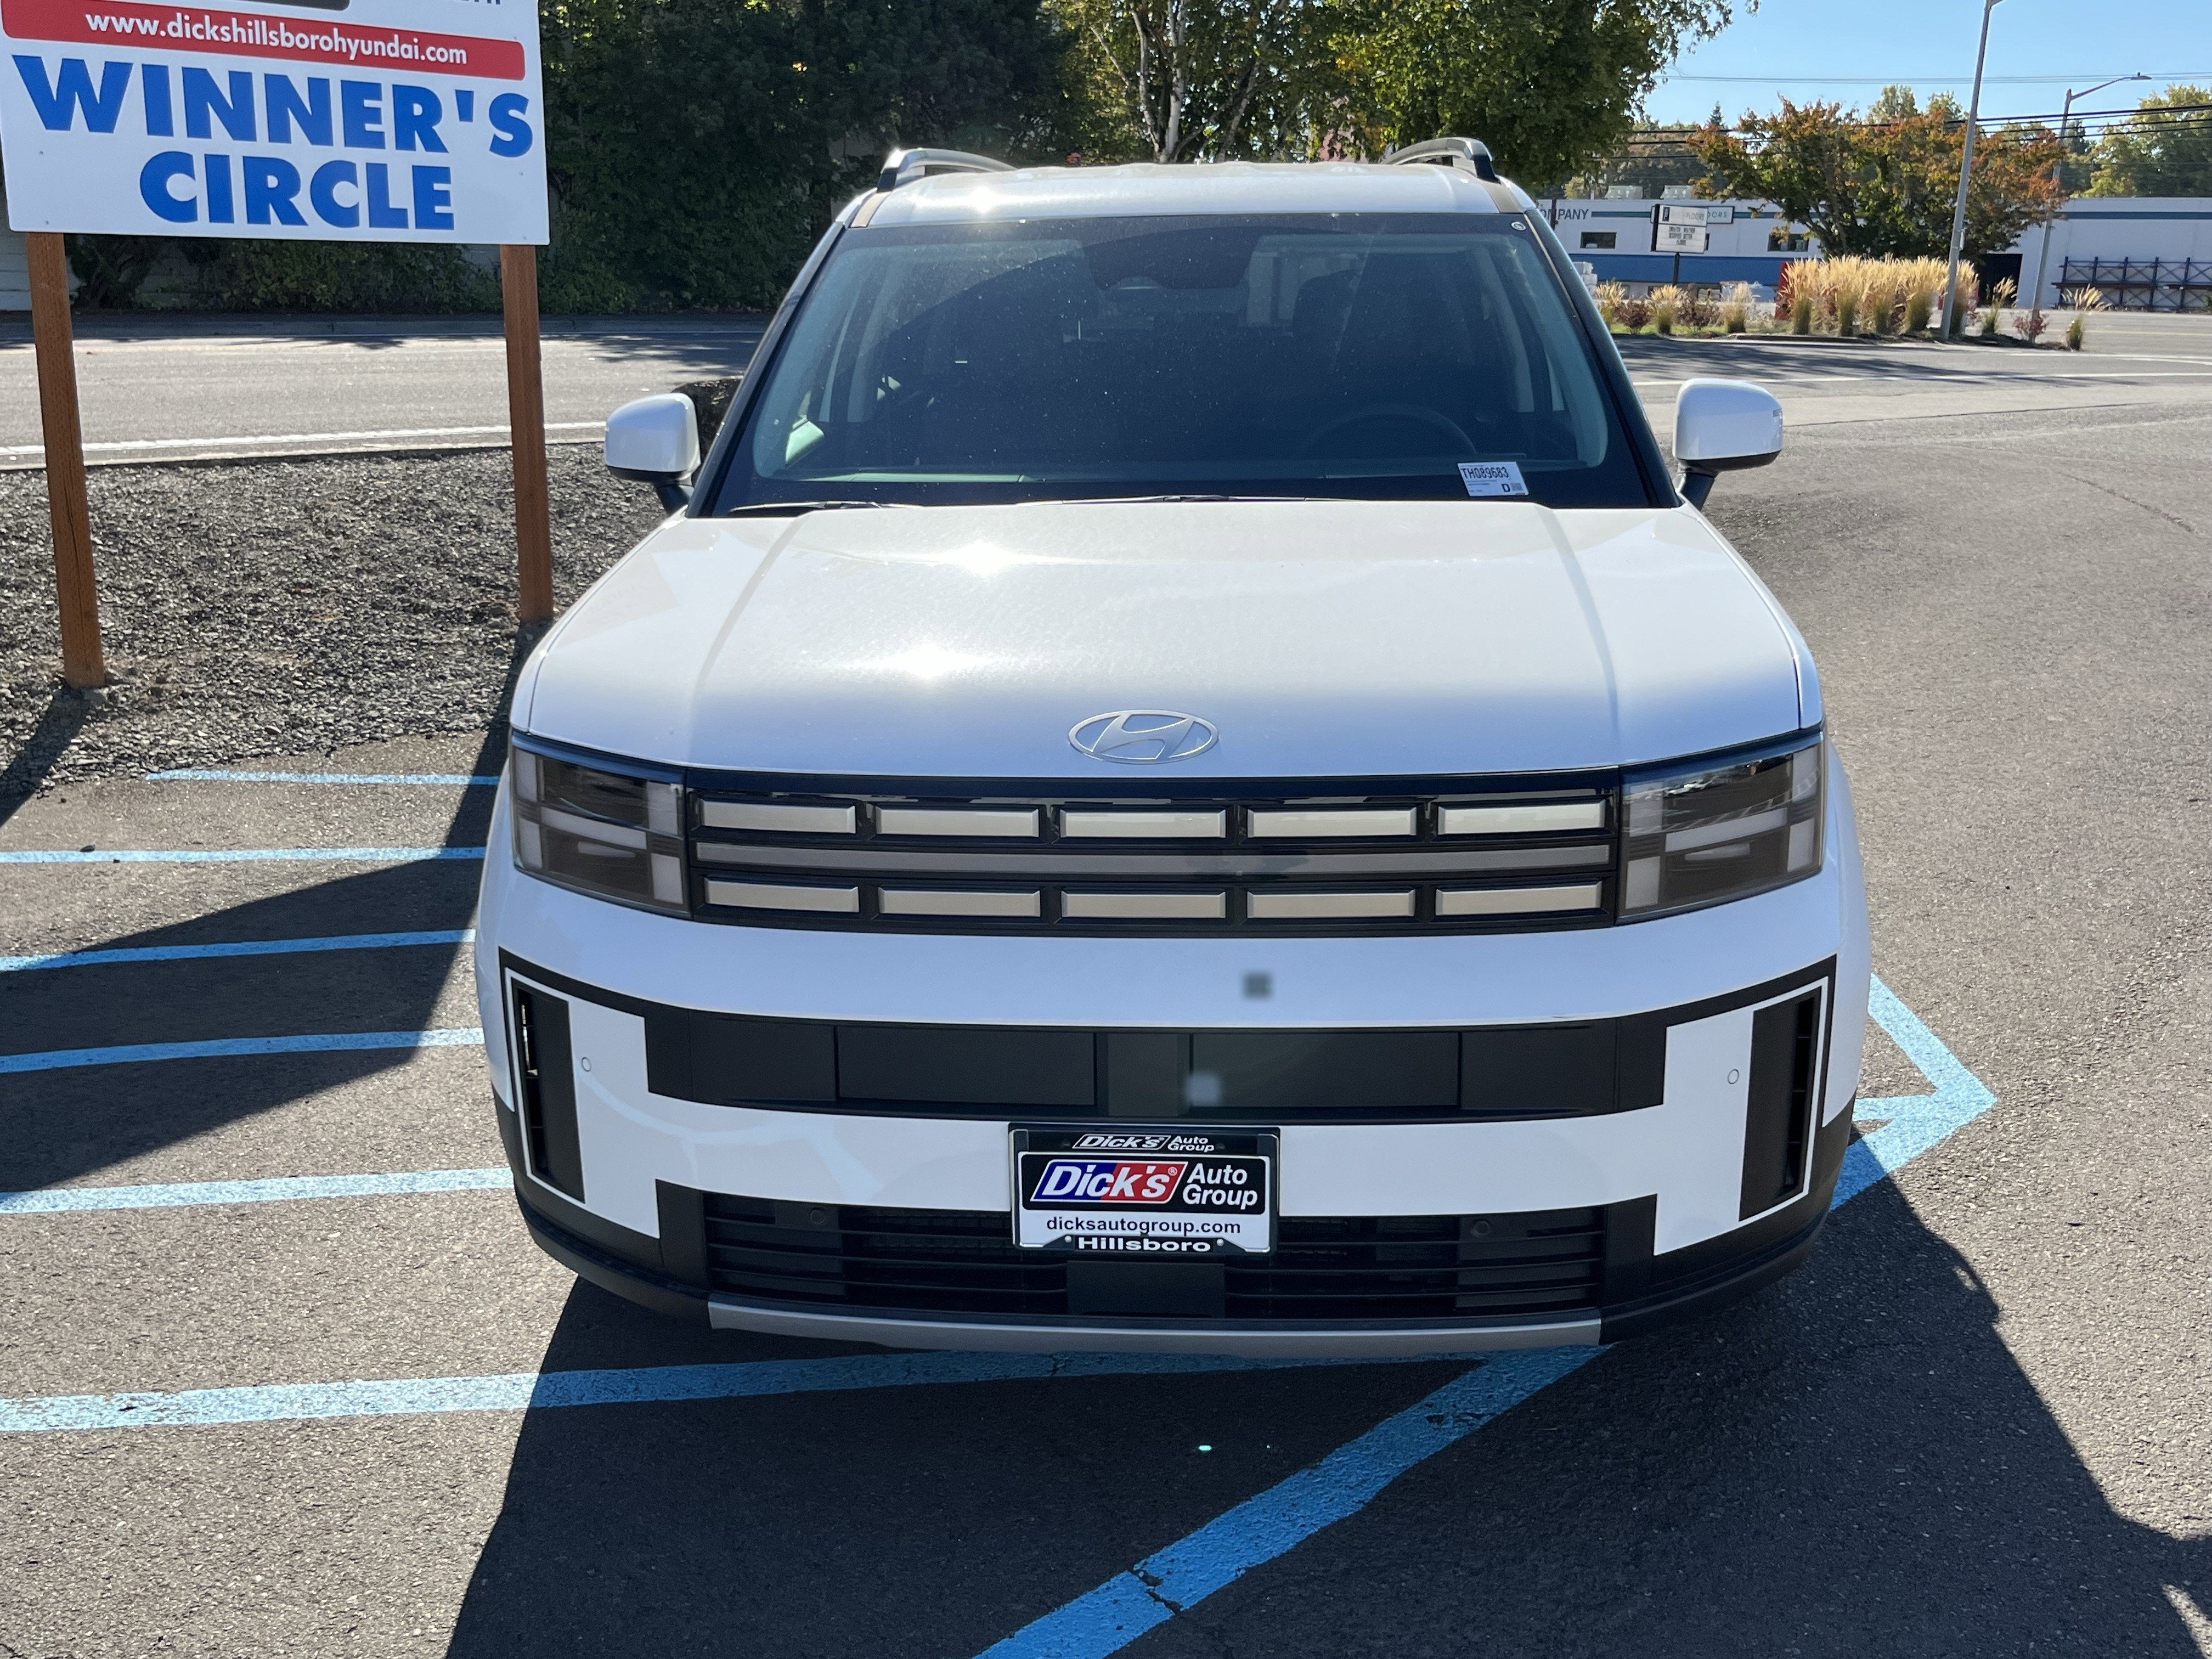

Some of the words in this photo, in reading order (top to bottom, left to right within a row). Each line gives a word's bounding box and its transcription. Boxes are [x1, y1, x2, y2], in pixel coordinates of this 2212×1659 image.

[85, 12, 467, 65] www.dickshillsborohyundai.com
[12, 54, 533, 157] WINNER'S
[140, 151, 454, 230] CIRCLE
[1502, 483, 1510, 492] D
[1080, 1135, 1161, 1148] Dick's
[1167, 1143, 1215, 1153] Group
[1171, 1135, 1209, 1144] Auto
[1042, 1165, 1167, 1198] Dick's
[1187, 1163, 1248, 1185] Auto
[1182, 1184, 1258, 1210] Group
[1046, 1216, 1241, 1234] dicksautogroup.com
[1078, 1237, 1211, 1252] Hillsboro
